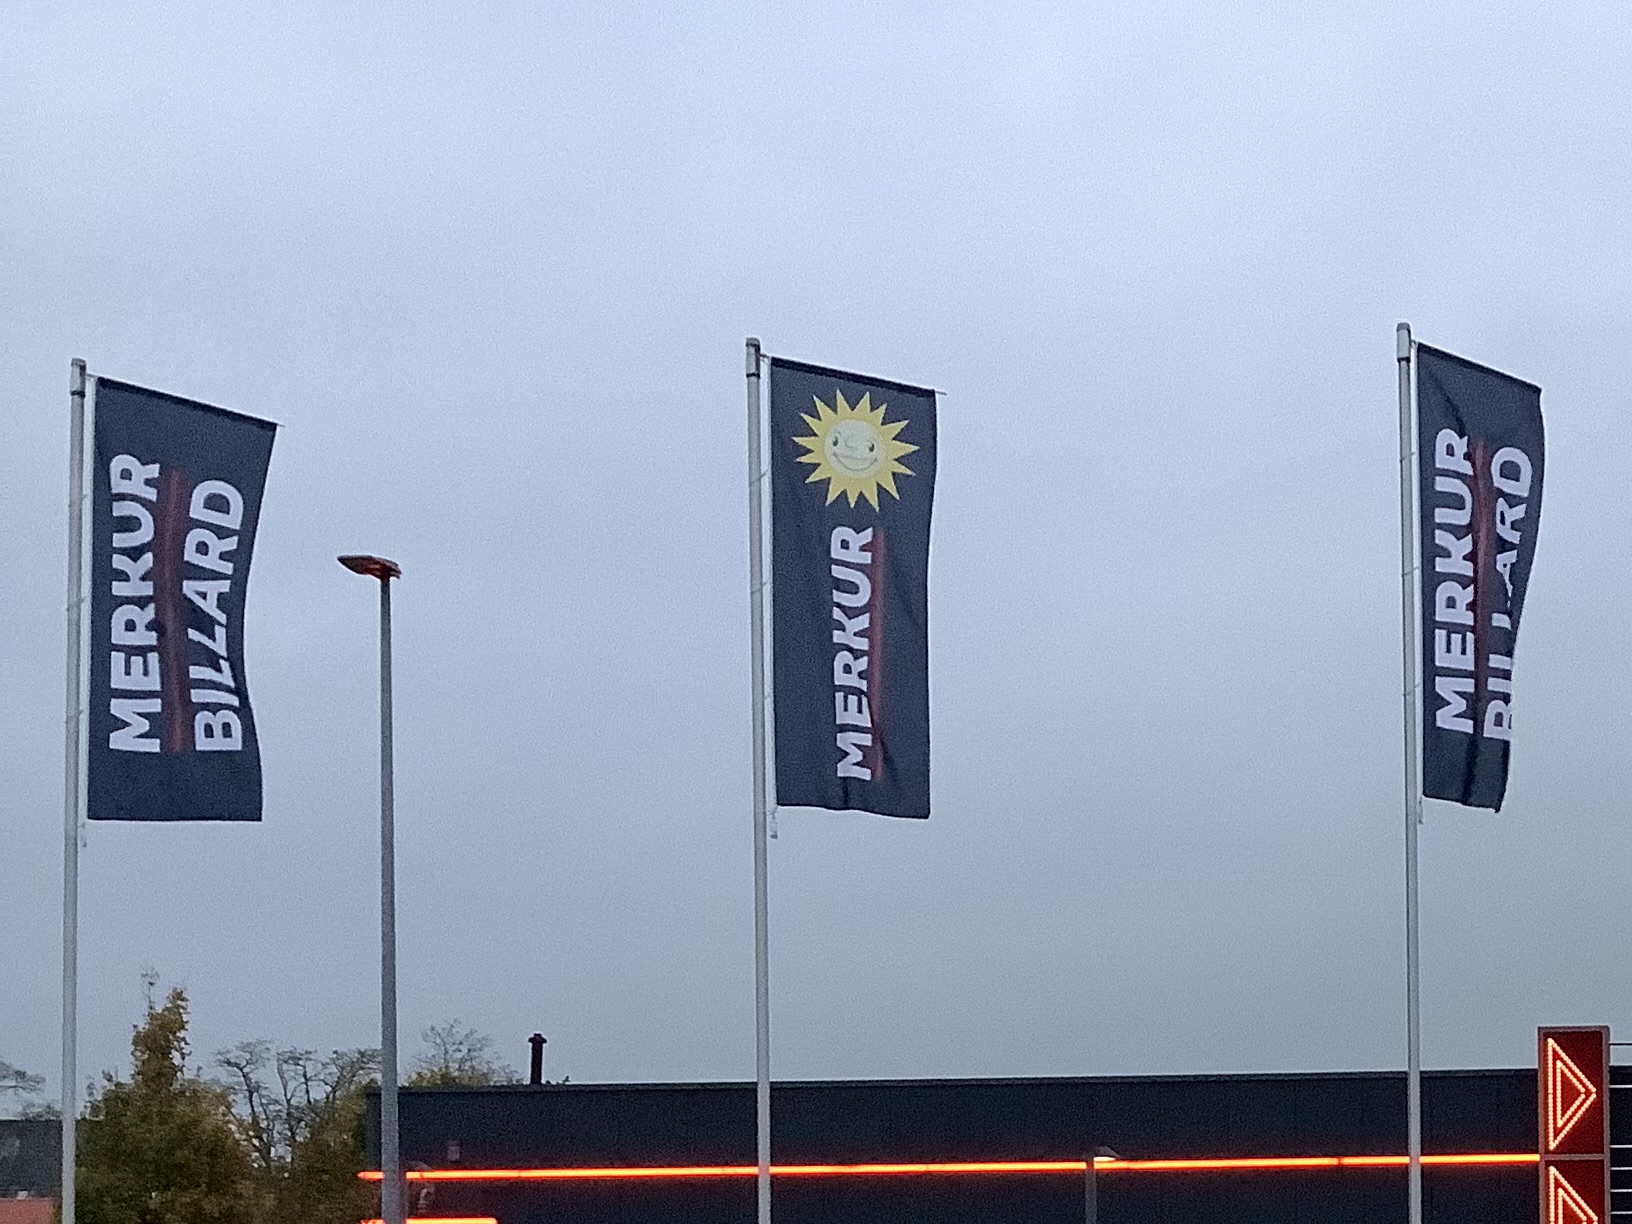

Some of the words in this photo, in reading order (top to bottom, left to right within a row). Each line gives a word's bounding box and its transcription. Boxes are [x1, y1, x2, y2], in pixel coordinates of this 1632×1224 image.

[108, 453, 162, 753] MERKUR
[182, 479, 245, 752] BILLARD
[830, 525, 875, 782] MERKUR
[1433, 427, 1476, 735] MERKUR
